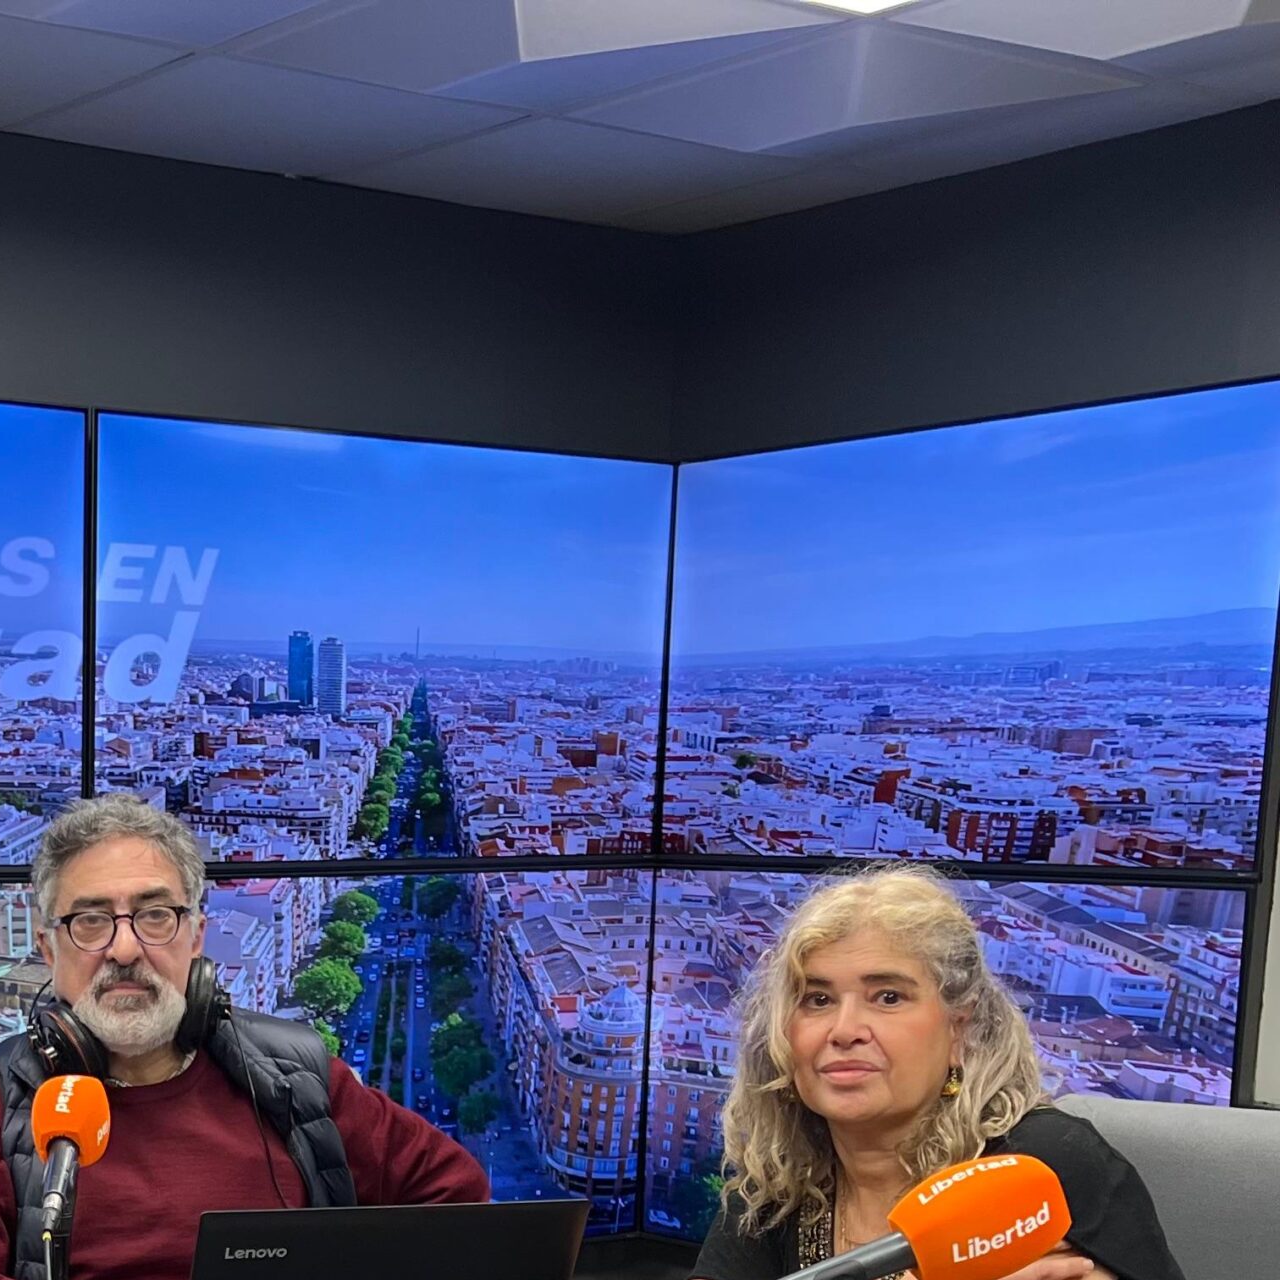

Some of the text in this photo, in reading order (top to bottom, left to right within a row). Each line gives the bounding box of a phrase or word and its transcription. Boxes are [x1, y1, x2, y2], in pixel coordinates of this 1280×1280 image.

[96, 542, 220, 605] EN
[917, 1156, 1019, 1205] Libertad
[224, 1247, 287, 1260] Lenovo
[952, 1201, 1050, 1264] Libertad
